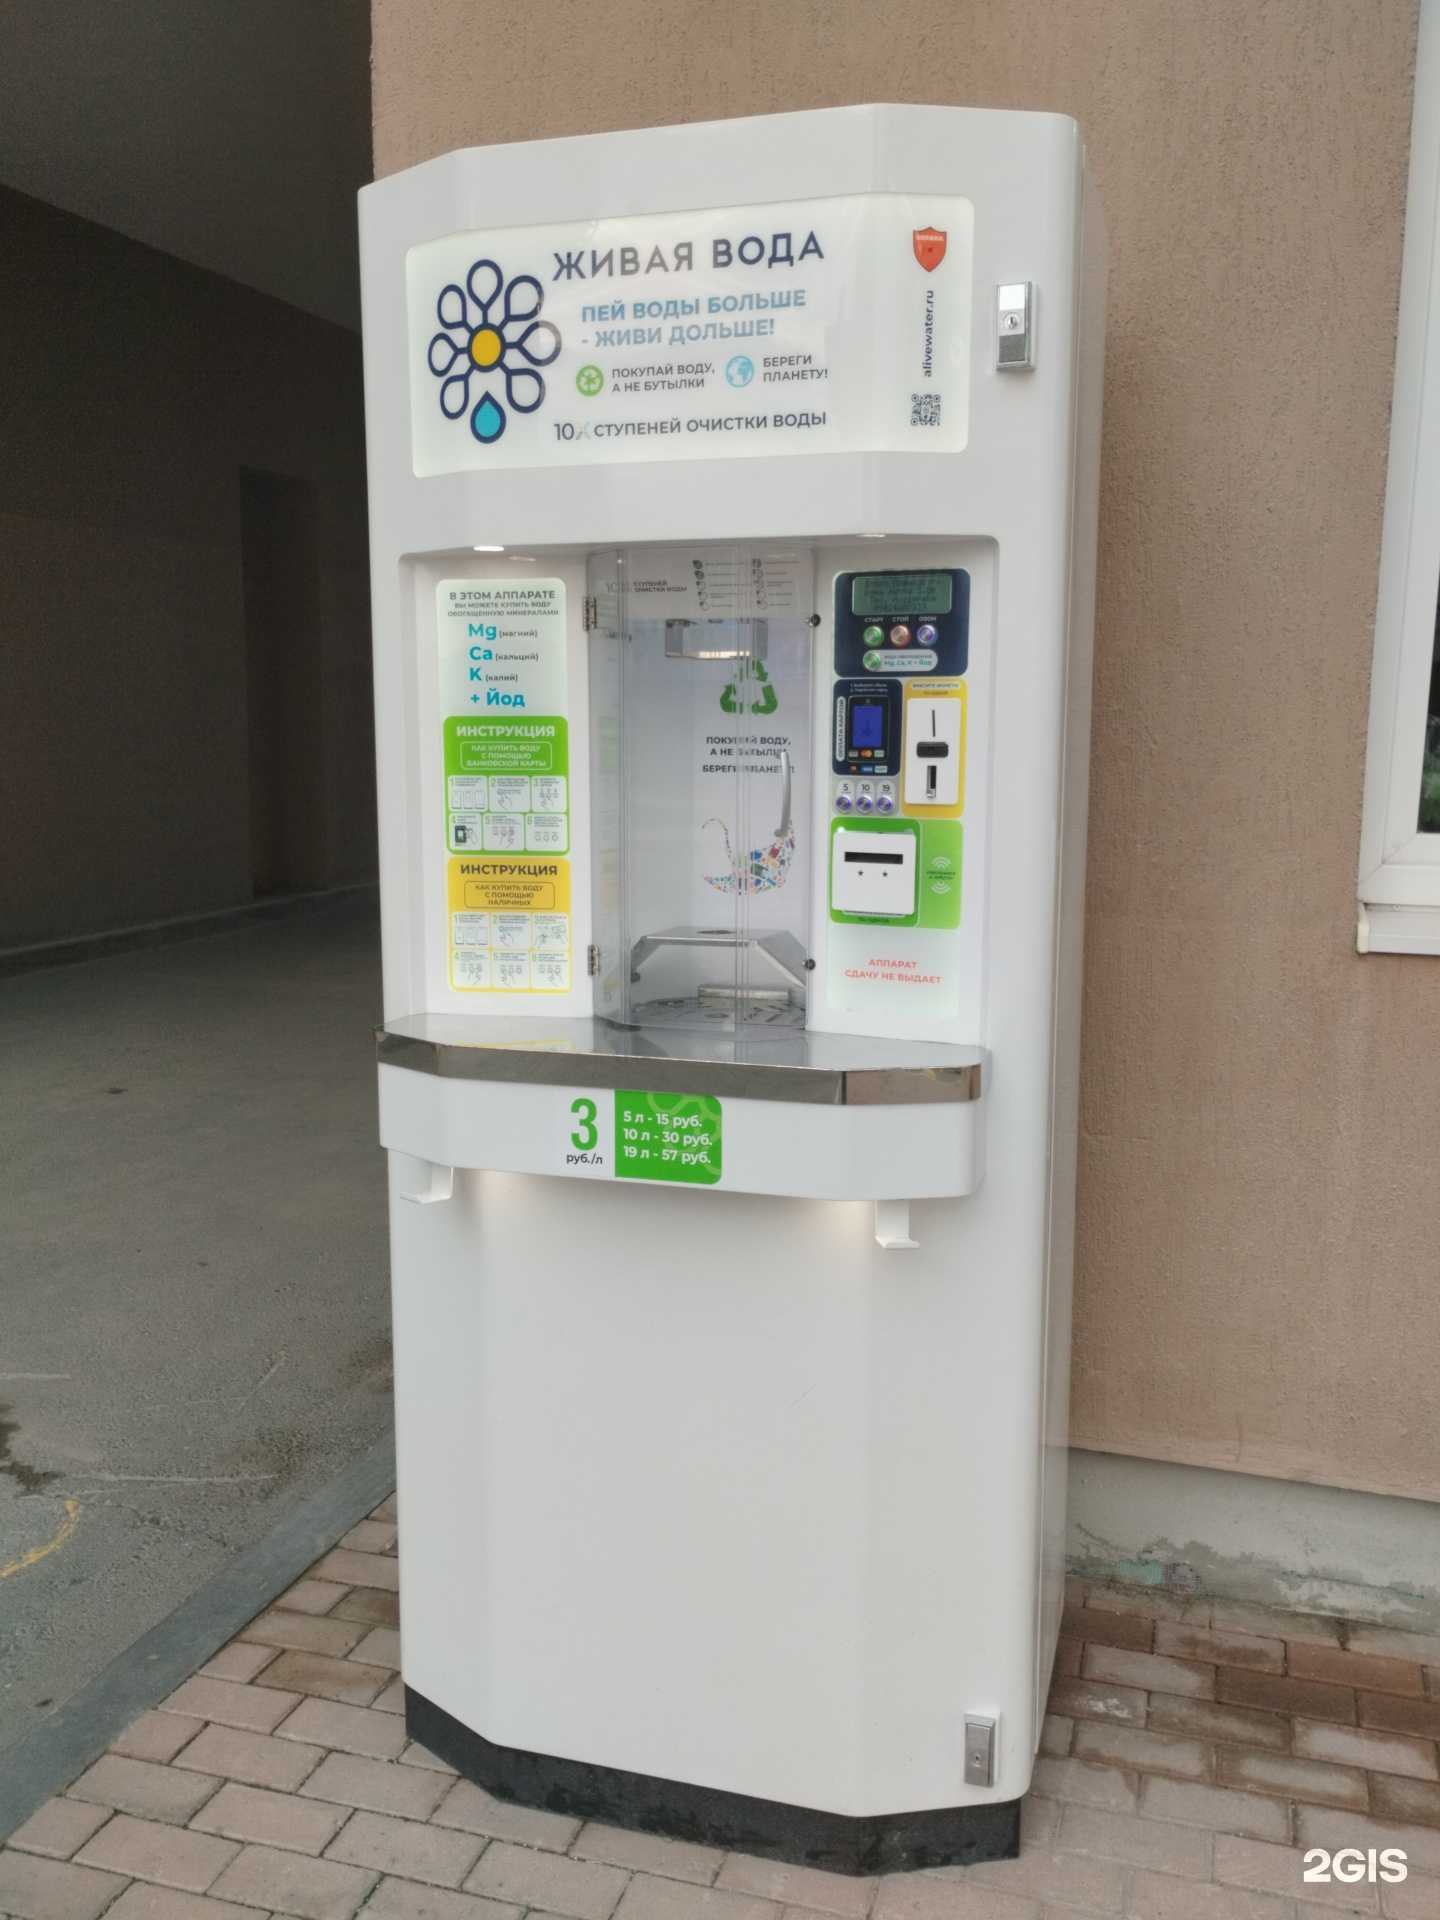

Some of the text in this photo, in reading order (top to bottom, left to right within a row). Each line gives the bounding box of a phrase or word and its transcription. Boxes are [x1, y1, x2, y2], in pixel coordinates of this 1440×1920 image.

[552, 230, 825, 281] ЖИВАЯ ВОДА
[582, 290, 807, 322] ПЕЙ ВОДЫ БОЛЬШЕ
[595, 327, 662, 347] ЖИВИ
[669, 319, 775, 346] ДОЛЬШЕ!
[922, 290, 934, 377] alivewater.ru
[763, 355, 812, 368] БЕРЕГИ
[612, 362, 716, 379] ПОКУПАЙ ВОДУ,
[763, 369, 828, 383] ПЛАНЕТУ!
[612, 378, 705, 393] А НЕ БУТЫЛКИ
[593, 418, 681, 438] СТУПЕНЕЙ
[686, 414, 768, 433] ОЧИСТКИ
[773, 411, 827, 429] ВОДЫ
[450, 590, 555, 600] В ЭТОМ АППАРАТЕ
[469, 624, 538, 640] Mg (магний)
[469, 646, 493, 661] Ca
[470, 688, 525, 707] + Йод
[457, 726, 555, 738] ИНСТРУКЦИЯ
[710, 748, 717, 756] А
[720, 748, 734, 756] НЕ
[843, 784, 849, 792] 5
[882, 784, 890, 792] 19
[461, 864, 558, 877] ИНСТРУКЦИЯ
[868, 959, 918, 969] АППАРАТ
[844, 970, 942, 984] СДАЧУ НЕ ВЫДАЕТ
[571, 1097, 598, 1151] 3
[623, 1111, 631, 1122] 5
[634, 1115, 644, 1123] л
[656, 1113, 669, 1125] 15
[672, 1115, 702, 1128] руб.
[623, 1128, 638, 1140] 10
[640, 1132, 650, 1141] л
[662, 1131, 679, 1143] 30
[683, 1133, 713, 1146] руб.
[566, 1153, 603, 1165] руб./л
[623, 1146, 637, 1158] 19
[639, 1149, 649, 1158] л
[662, 1149, 678, 1161] 57
[681, 1152, 711, 1165] руб.
